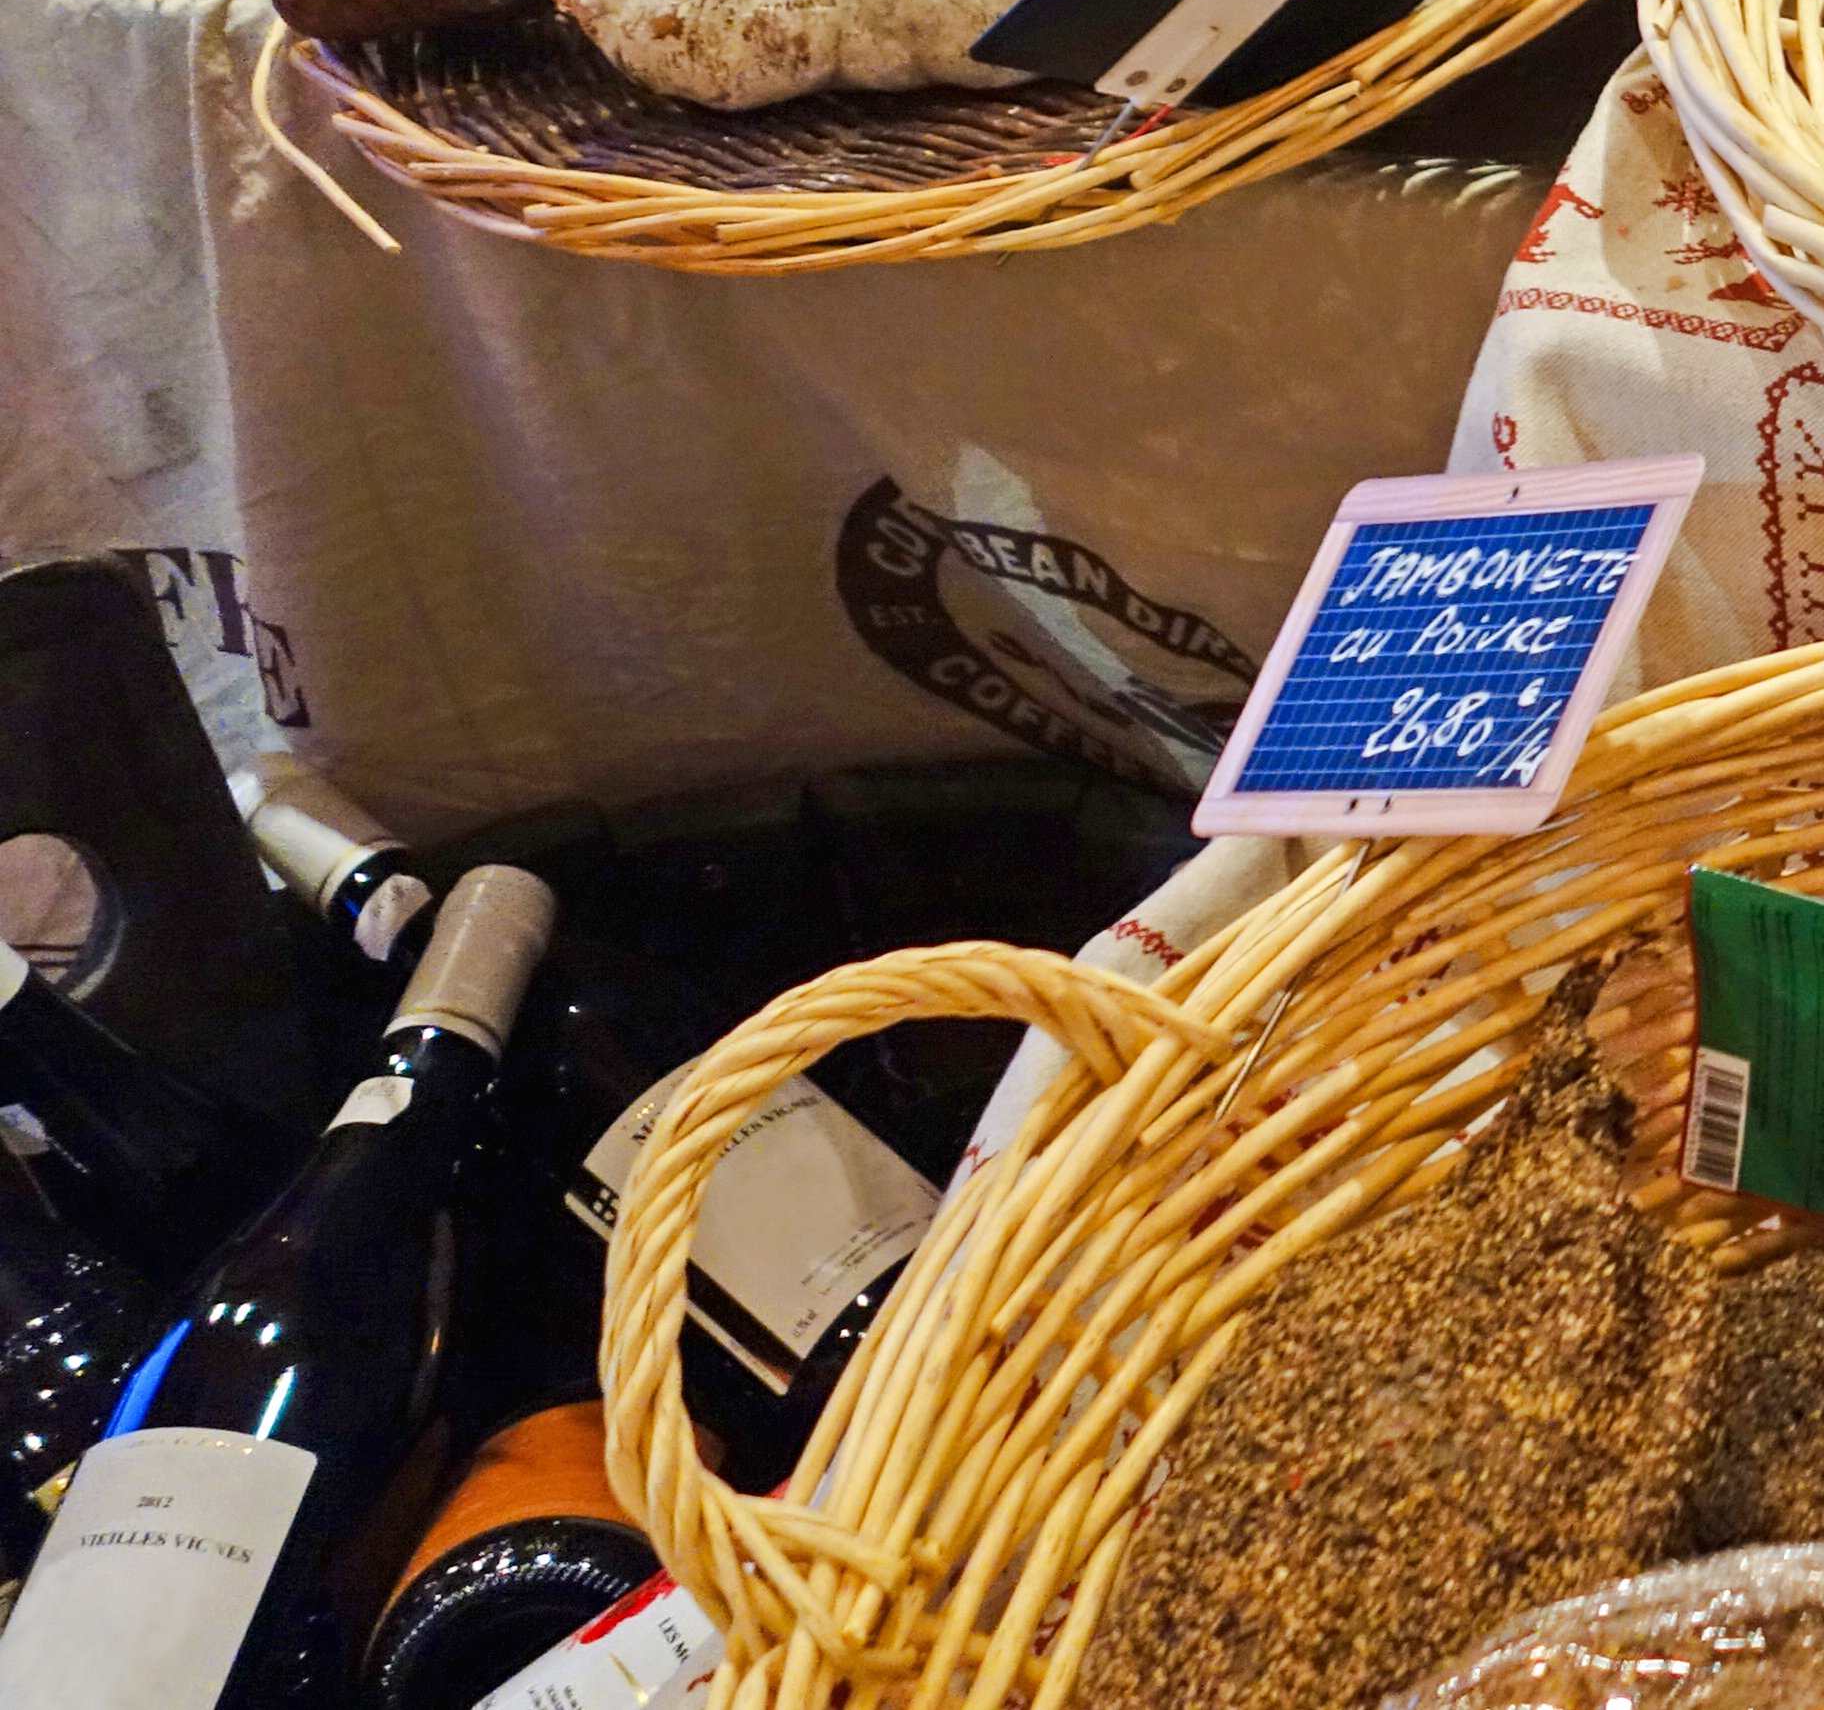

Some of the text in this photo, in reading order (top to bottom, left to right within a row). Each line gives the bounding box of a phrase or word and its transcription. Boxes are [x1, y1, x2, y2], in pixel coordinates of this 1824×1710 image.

[952, 528, 1111, 604] BEAN
[1340, 542, 1643, 608] JAMBONETTE
[1330, 627, 1391, 664] au
[136, 1494, 175, 1510] 2012
